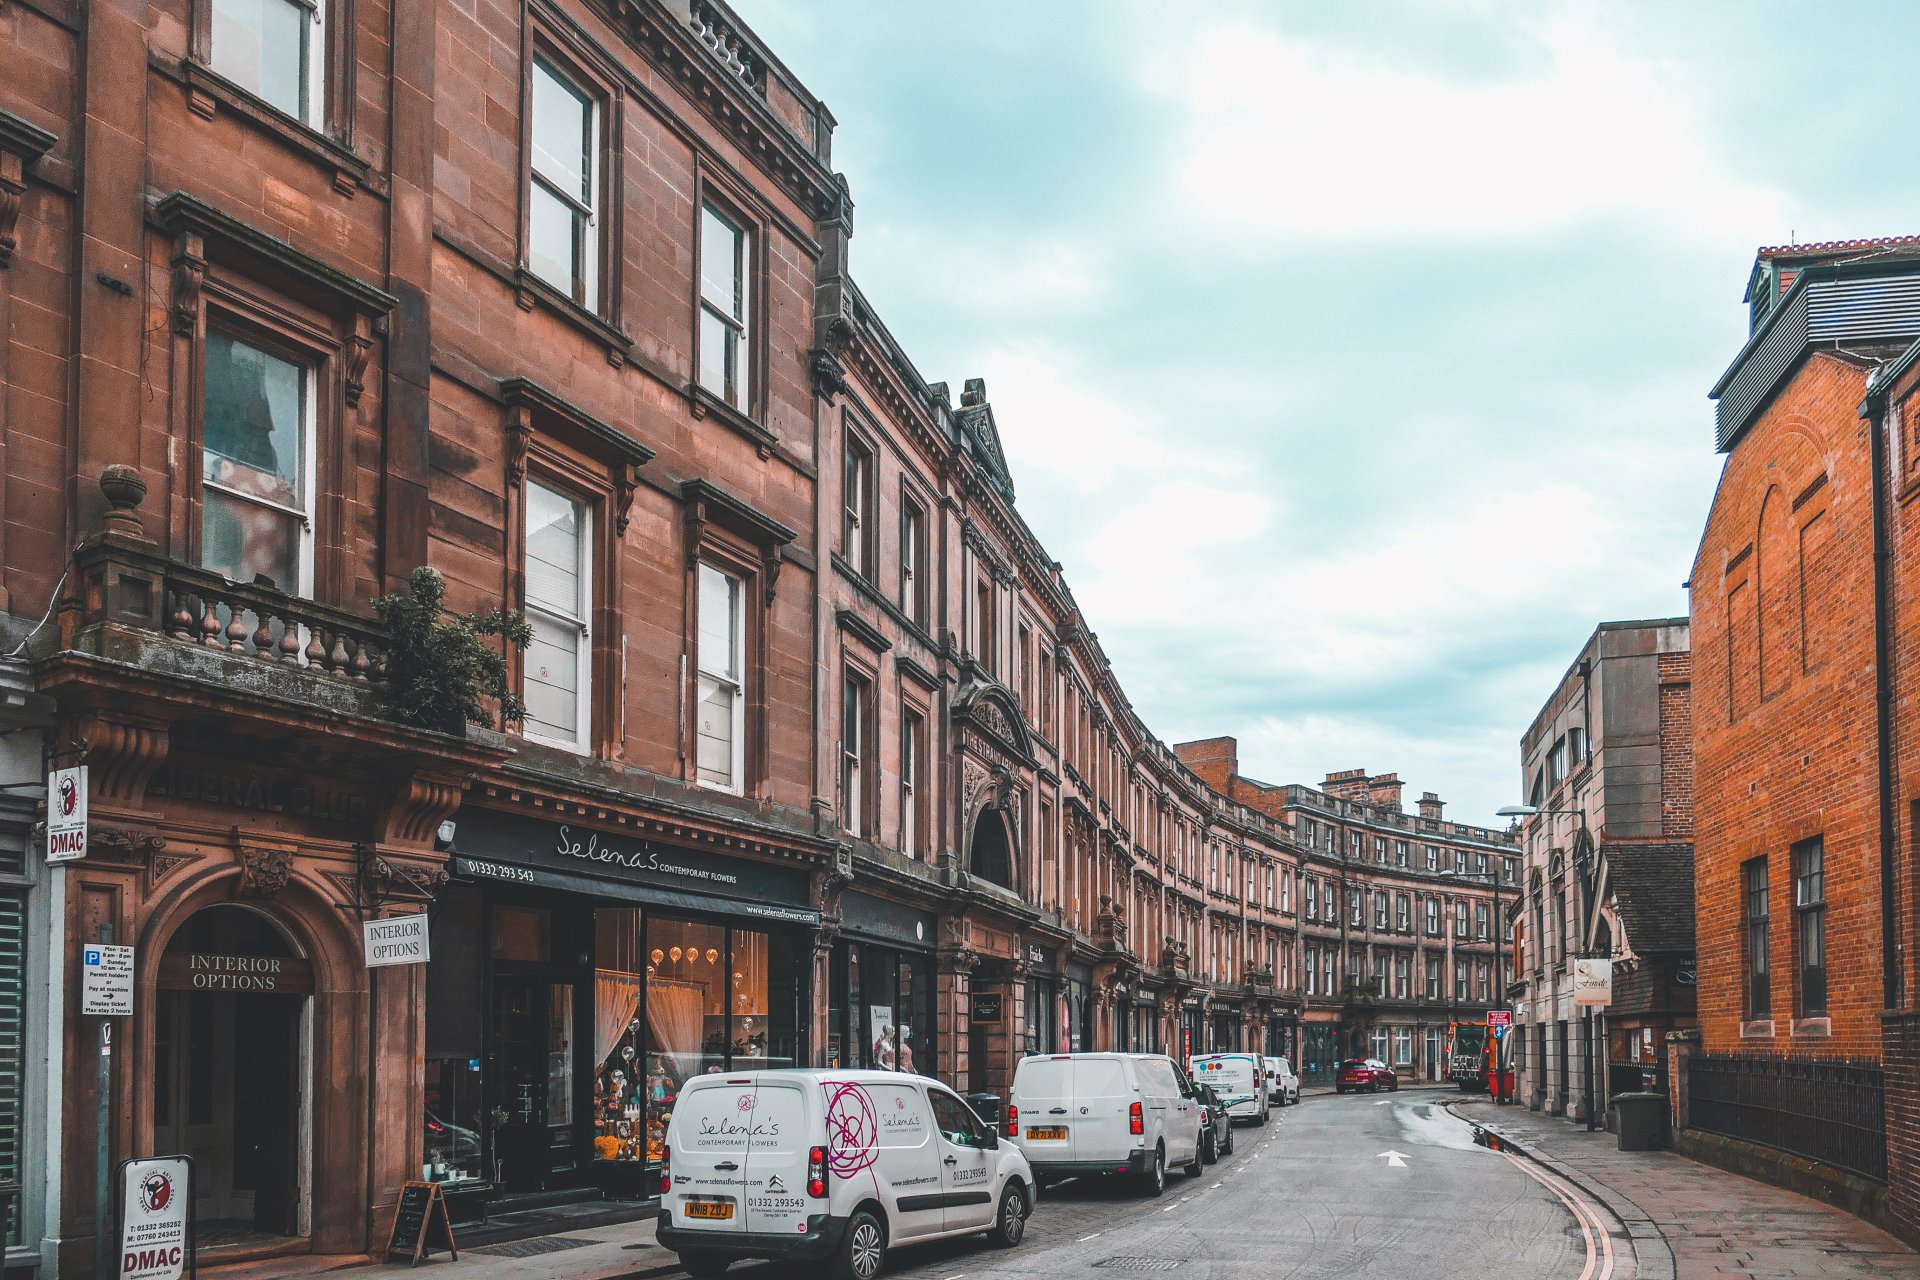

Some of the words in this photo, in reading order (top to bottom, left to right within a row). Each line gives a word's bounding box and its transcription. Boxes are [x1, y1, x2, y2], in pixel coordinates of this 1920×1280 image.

[50, 830, 84, 854] DMAC
[557, 825, 658, 870] Selena's
[468, 860, 496, 876] 01332
[499, 865, 516, 879] 293
[518, 869, 534, 882] 543
[660, 863, 710, 879] CONTEMPORARY
[711, 872, 737, 884] FLOWERS
[746, 905, 815, 922] www.selenasflowers.com
[370, 922, 420, 940] INTERIOR
[373, 942, 420, 959] OPTIONS
[190, 954, 281, 973] INTERIOR
[193, 973, 276, 990] OPTIONS
[698, 1116, 779, 1136] Selena's
[882, 1112, 920, 1126] Selena's
[140, 1170, 158, 1189] MARTIAL
[163, 1171, 173, 1183] ARTS
[695, 1178, 762, 1186] www.selenasflowers.com
[953, 1170, 968, 1180] 01332
[970, 1168, 986, 1178] 293543
[710, 1205, 727, 1216] ZDJ
[748, 1198, 772, 1207] 01332
[775, 1198, 805, 1208] 293543
[137, 1223, 157, 1232] 01332
[123, 1247, 181, 1272] DMAC
[130, 1272, 156, 1280] Confidence
